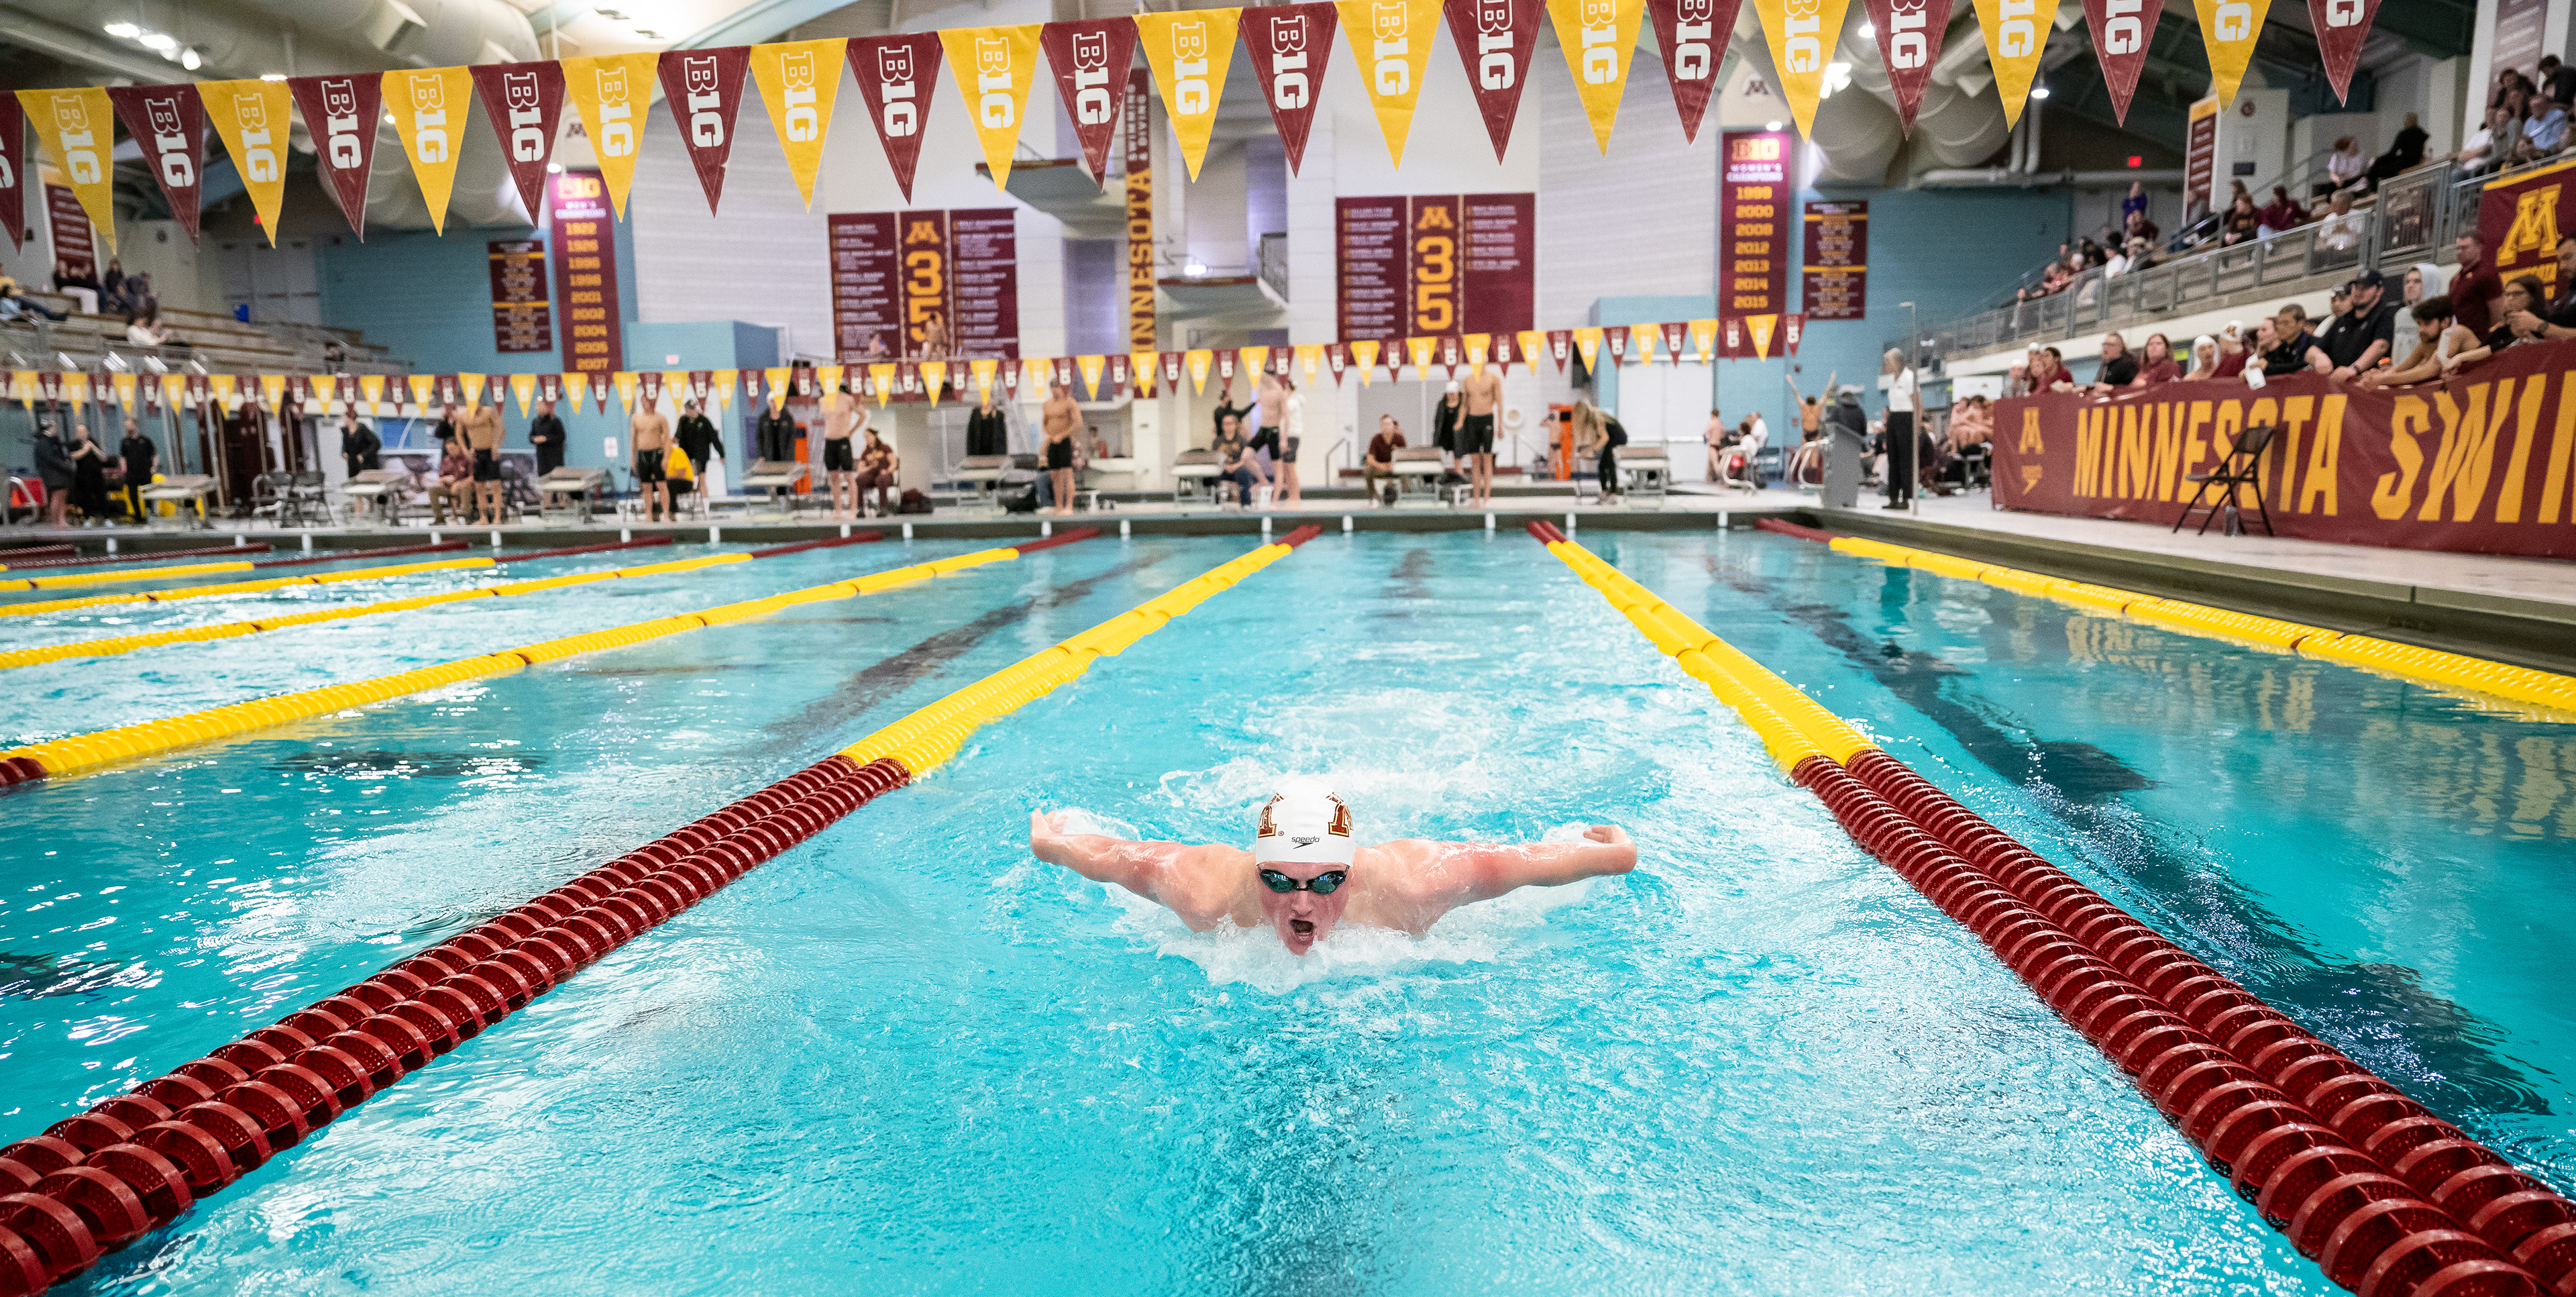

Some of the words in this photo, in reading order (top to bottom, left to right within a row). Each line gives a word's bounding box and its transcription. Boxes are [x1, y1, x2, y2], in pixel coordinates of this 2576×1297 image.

[1127, 169, 1156, 373] INNESOTA
[1735, 205, 1774, 218] 2000
[2074, 393, 2347, 516] MINNESOTA
